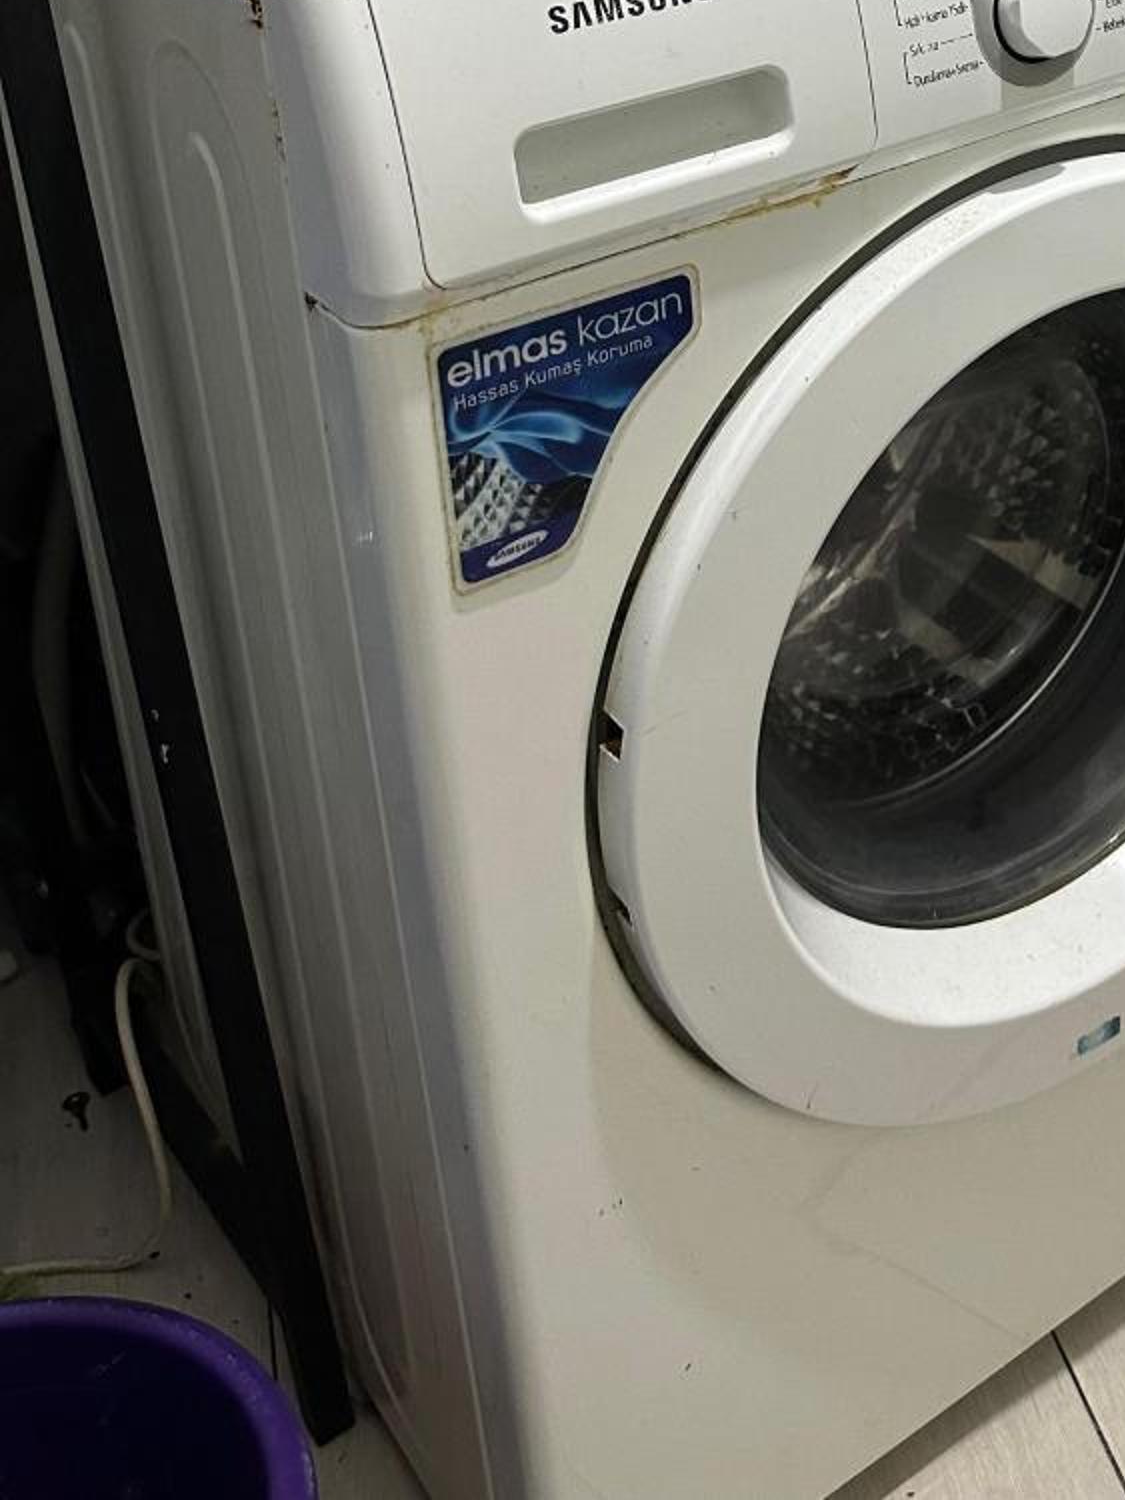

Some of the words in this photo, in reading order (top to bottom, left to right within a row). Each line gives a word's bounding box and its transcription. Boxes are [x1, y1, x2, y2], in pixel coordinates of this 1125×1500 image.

[447, 327, 568, 389] elmas
[576, 291, 684, 347] kazan
[453, 380, 520, 413] Hassas
[524, 357, 582, 388] Kumaş
[587, 334, 654, 368] Koruma
